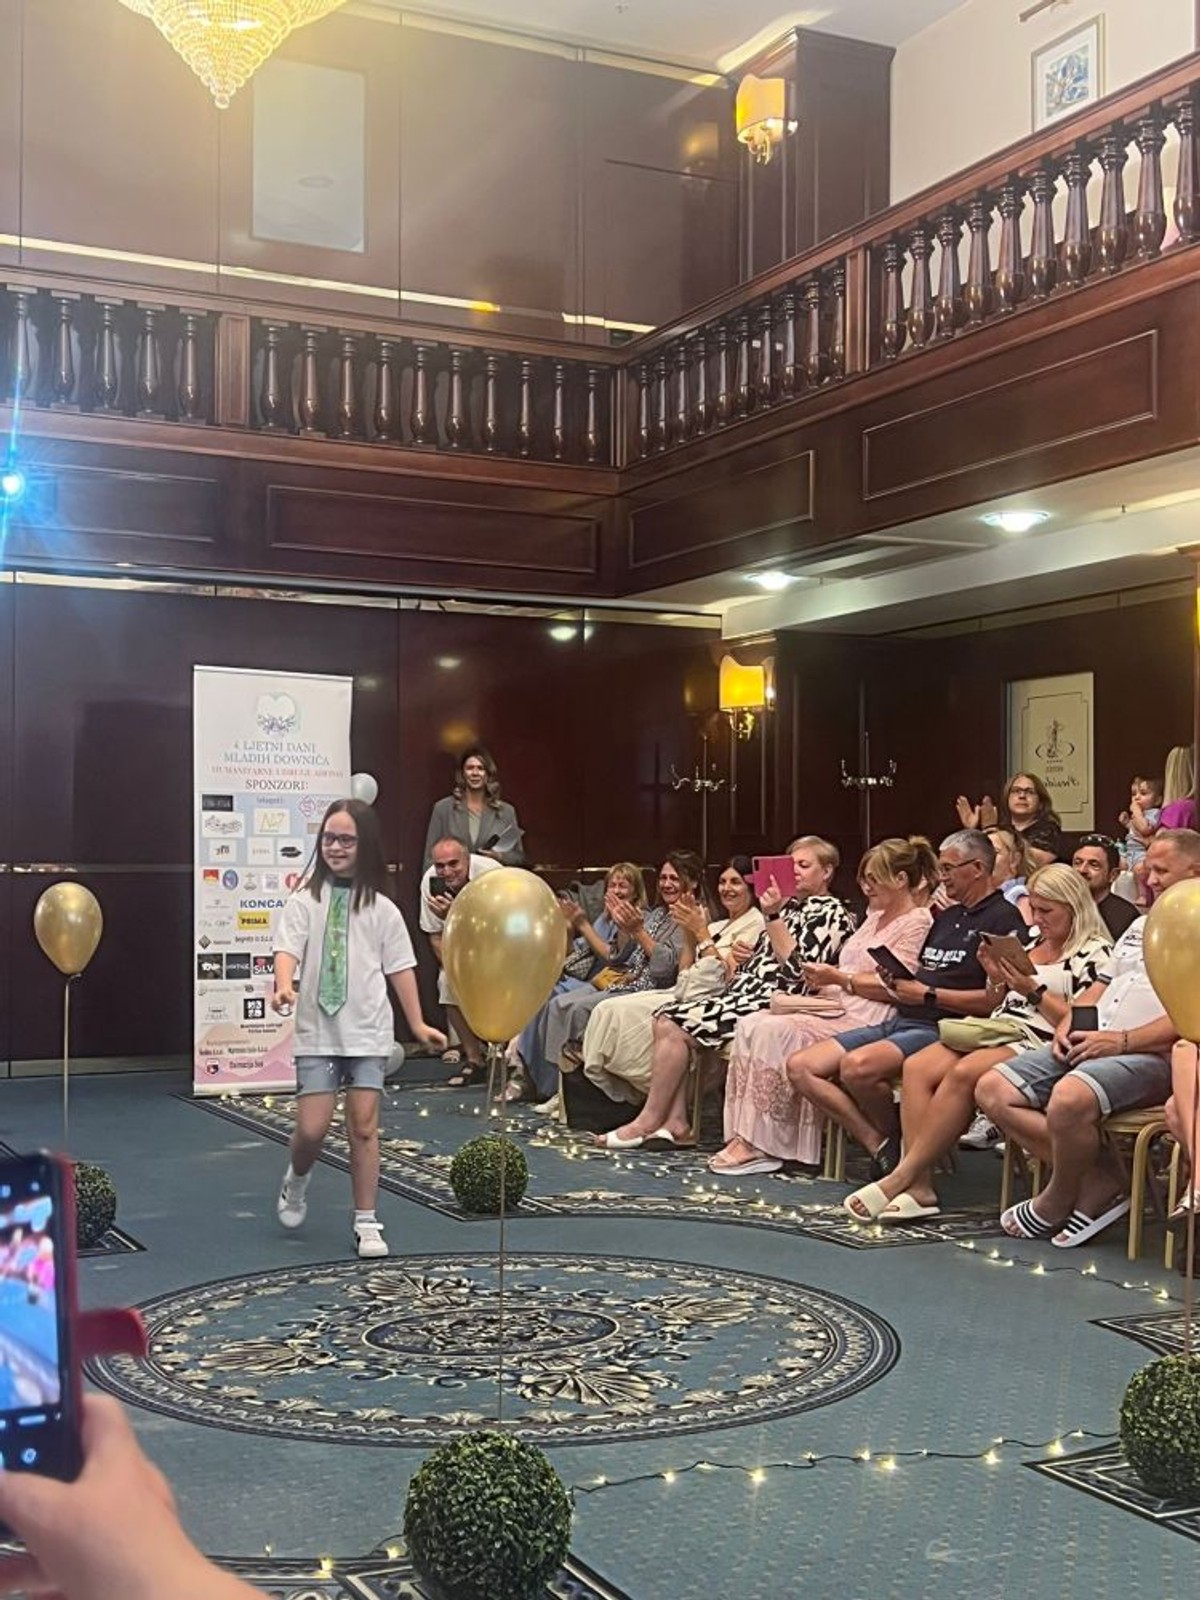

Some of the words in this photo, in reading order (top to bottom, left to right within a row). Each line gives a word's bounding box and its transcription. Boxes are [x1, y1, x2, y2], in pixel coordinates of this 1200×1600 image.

[287, 742, 316, 753] DANI
[224, 752, 271, 764] MLADIH
[245, 779, 309, 791] SPONZORI:
[240, 898, 288, 909] KONCA
